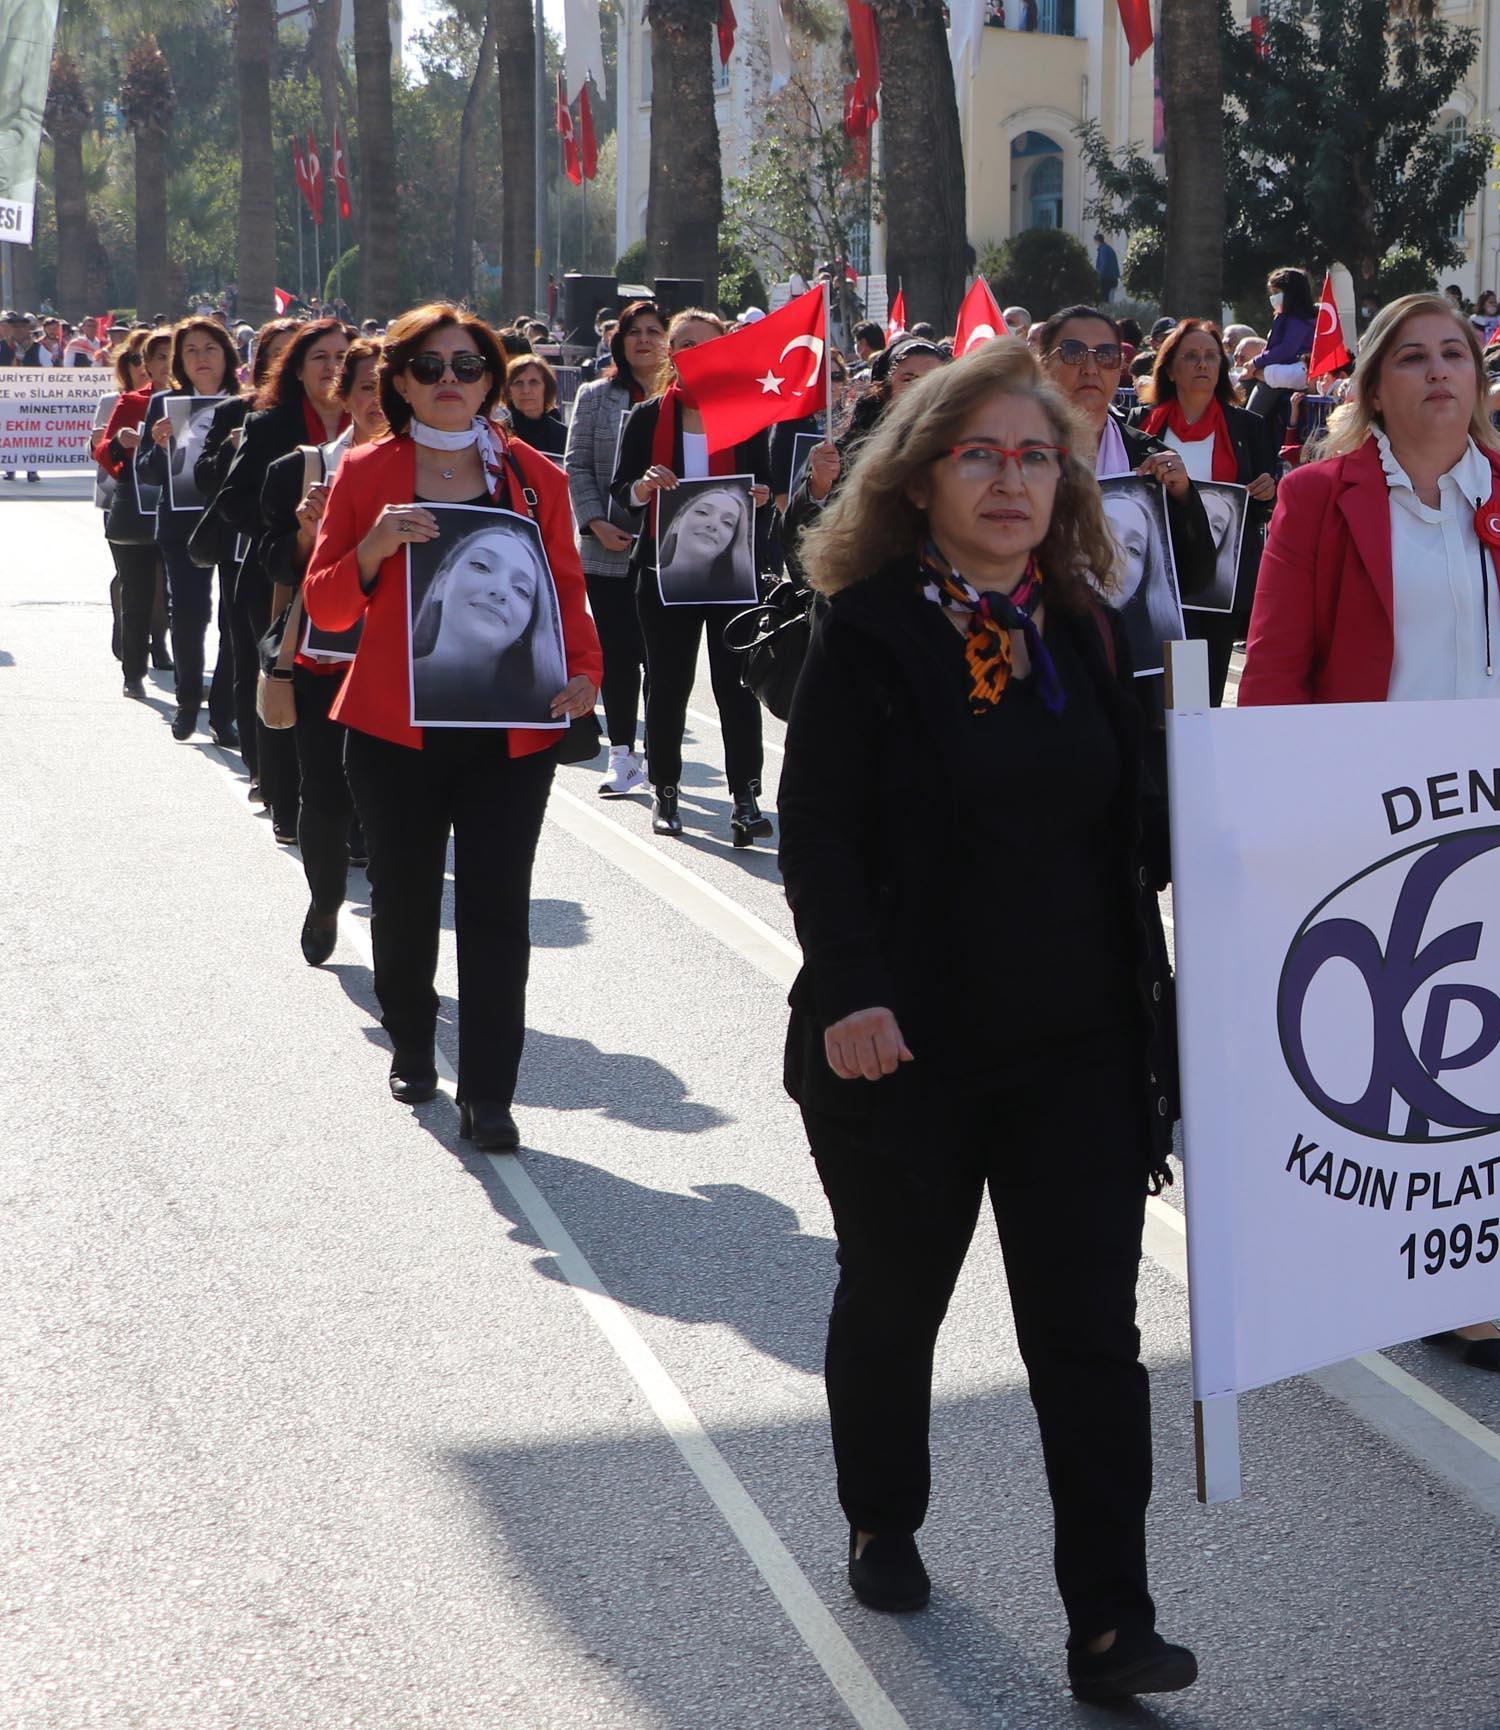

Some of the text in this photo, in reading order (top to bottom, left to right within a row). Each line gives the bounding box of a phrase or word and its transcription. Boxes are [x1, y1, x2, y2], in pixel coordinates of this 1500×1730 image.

[48, 373, 74, 383] BİZE
[14, 390, 26, 399] ve
[30, 387, 64, 399] SİLAH
[20, 402, 96, 415] MİNNETTARIZ
[6, 419, 41, 432] EKİM
[1285, 1132, 1398, 1211] KADIN
[1400, 1217, 1500, 1280] 1995
